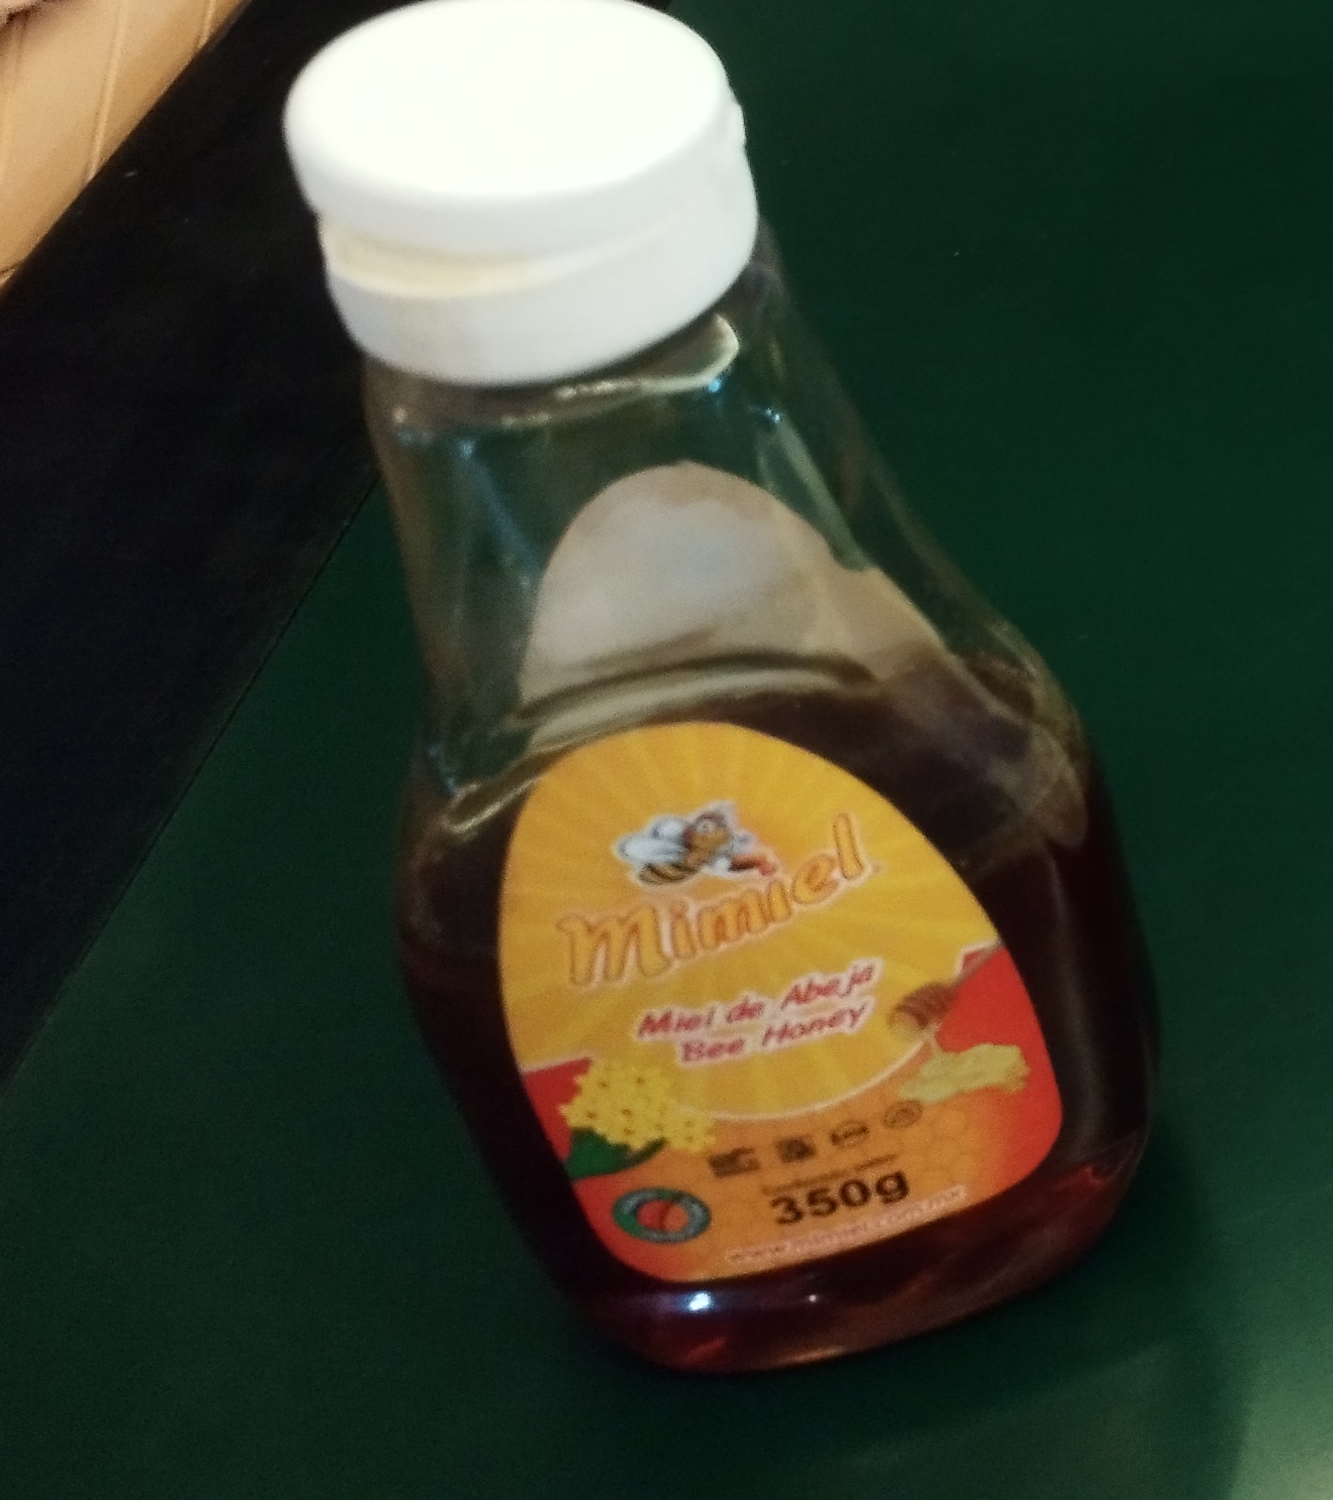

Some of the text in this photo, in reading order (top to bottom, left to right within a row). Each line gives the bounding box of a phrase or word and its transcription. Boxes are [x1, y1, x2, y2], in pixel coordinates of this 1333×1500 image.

[556, 813, 863, 988] Mimiel
[637, 963, 875, 1039] Miel de Abeja
[681, 1004, 867, 1064] Bee Honey
[772, 1169, 909, 1225] 350g
